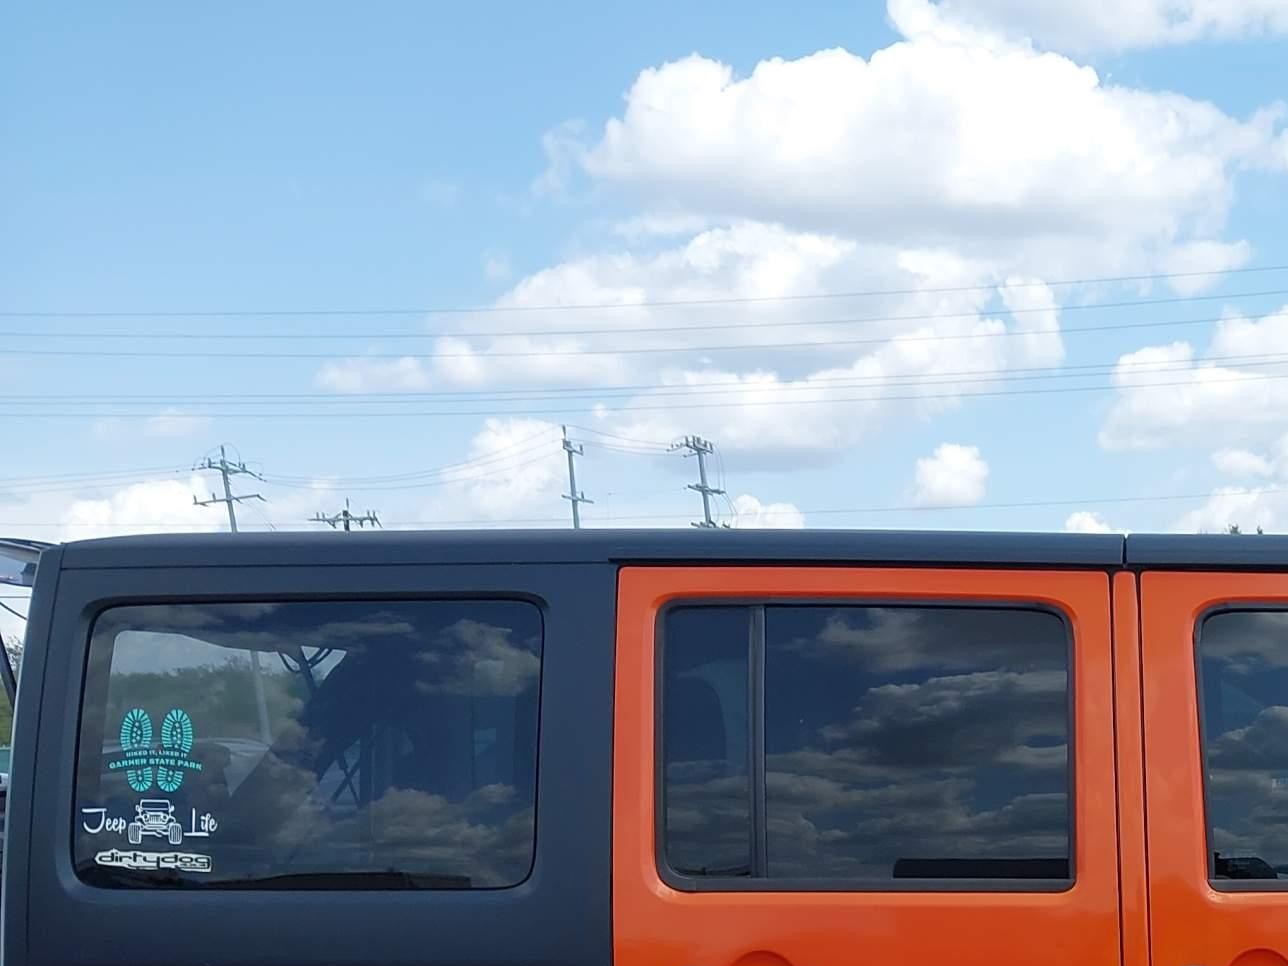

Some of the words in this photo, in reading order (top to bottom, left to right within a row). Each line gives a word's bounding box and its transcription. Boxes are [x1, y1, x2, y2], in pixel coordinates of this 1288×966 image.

[109, 758, 147, 769] GARNER
[177, 759, 202, 770] PARK
[82, 808, 126, 834] Jeep
[184, 808, 218, 836] Life
